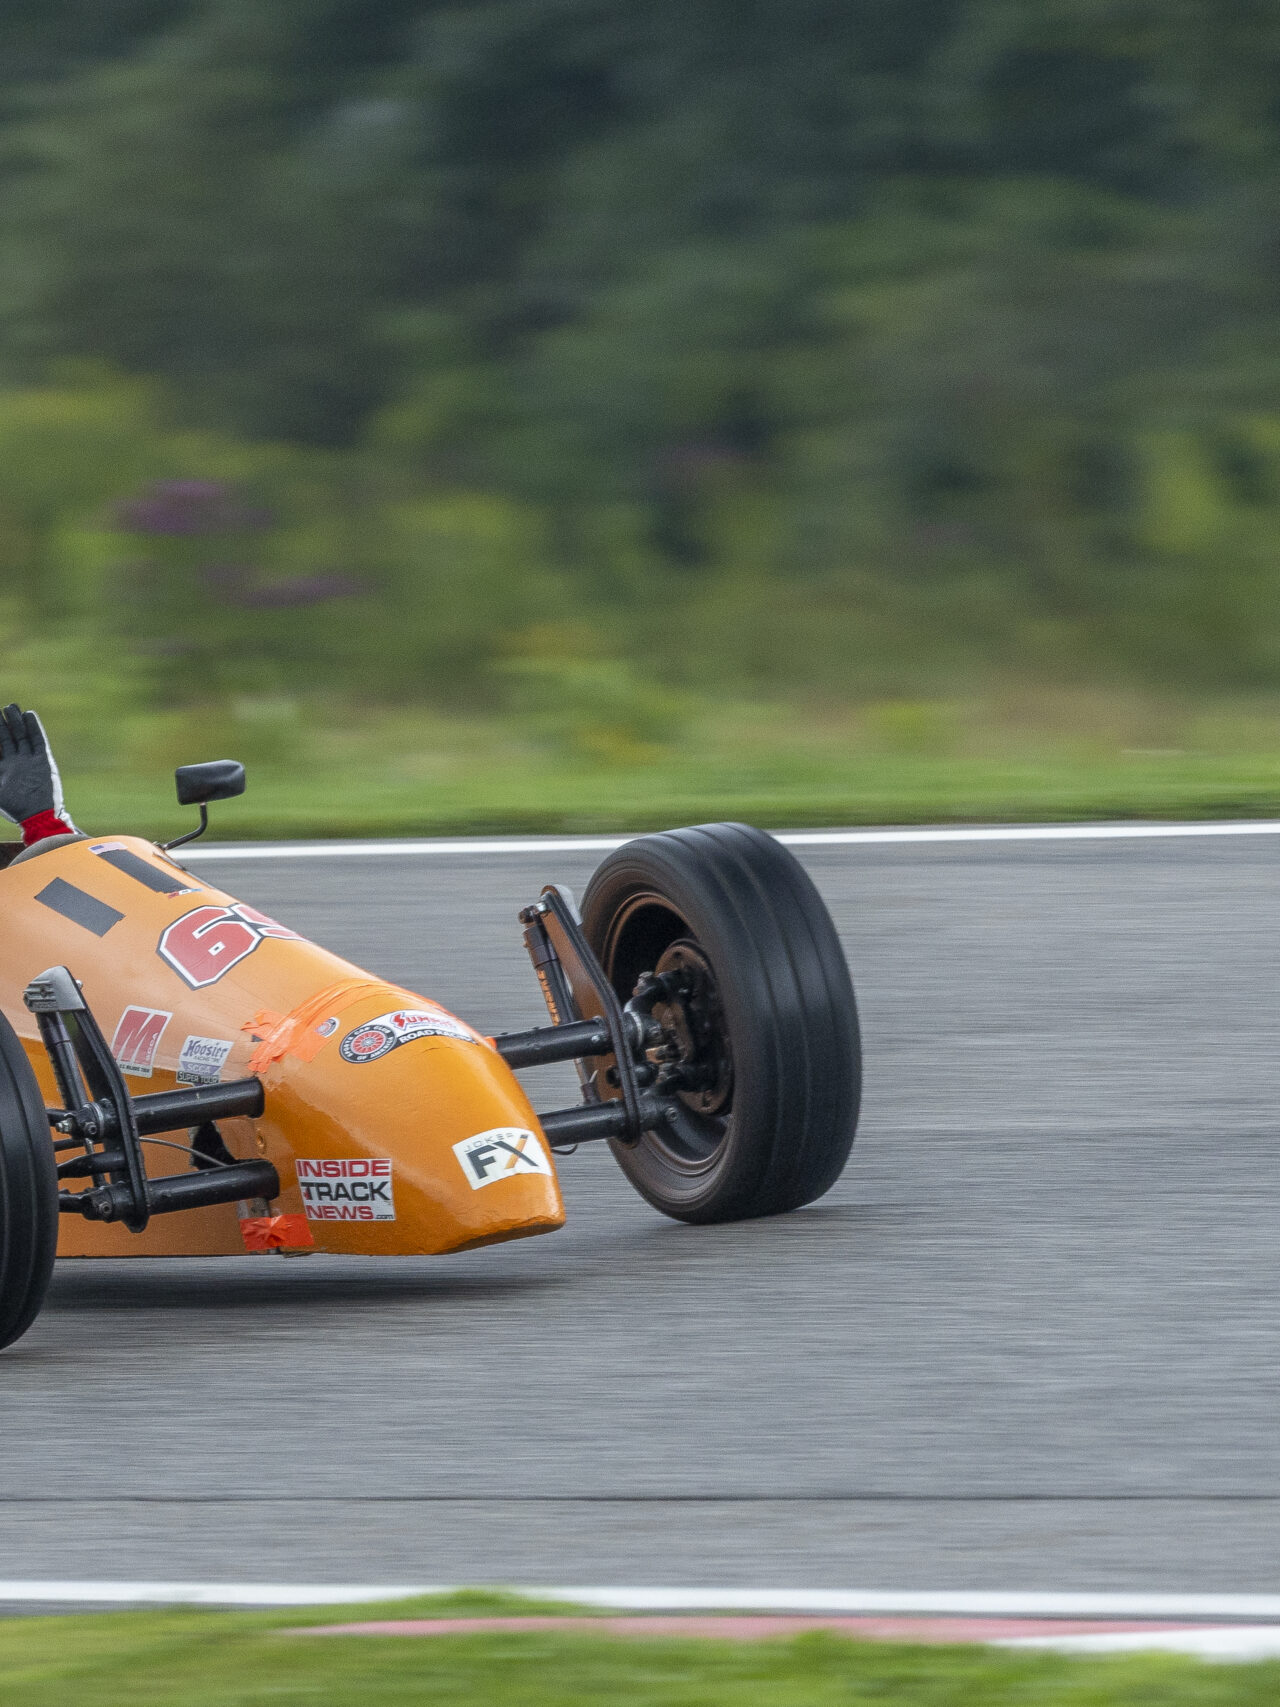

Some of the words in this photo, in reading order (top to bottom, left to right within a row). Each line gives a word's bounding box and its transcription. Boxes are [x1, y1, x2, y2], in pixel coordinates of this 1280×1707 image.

[353, 1026, 370, 1036] CAR
[373, 1025, 391, 1034] CLUB
[399, 1029, 435, 1043] ROAD
[182, 1040, 229, 1058] Hoosier
[178, 1071, 199, 1082] SUPER
[200, 1075, 217, 1084] TOUR
[466, 1134, 539, 1179] FX
[297, 1160, 390, 1177] INSIDE
[301, 1181, 391, 1201] TRACK
[305, 1205, 374, 1219] NEWS
